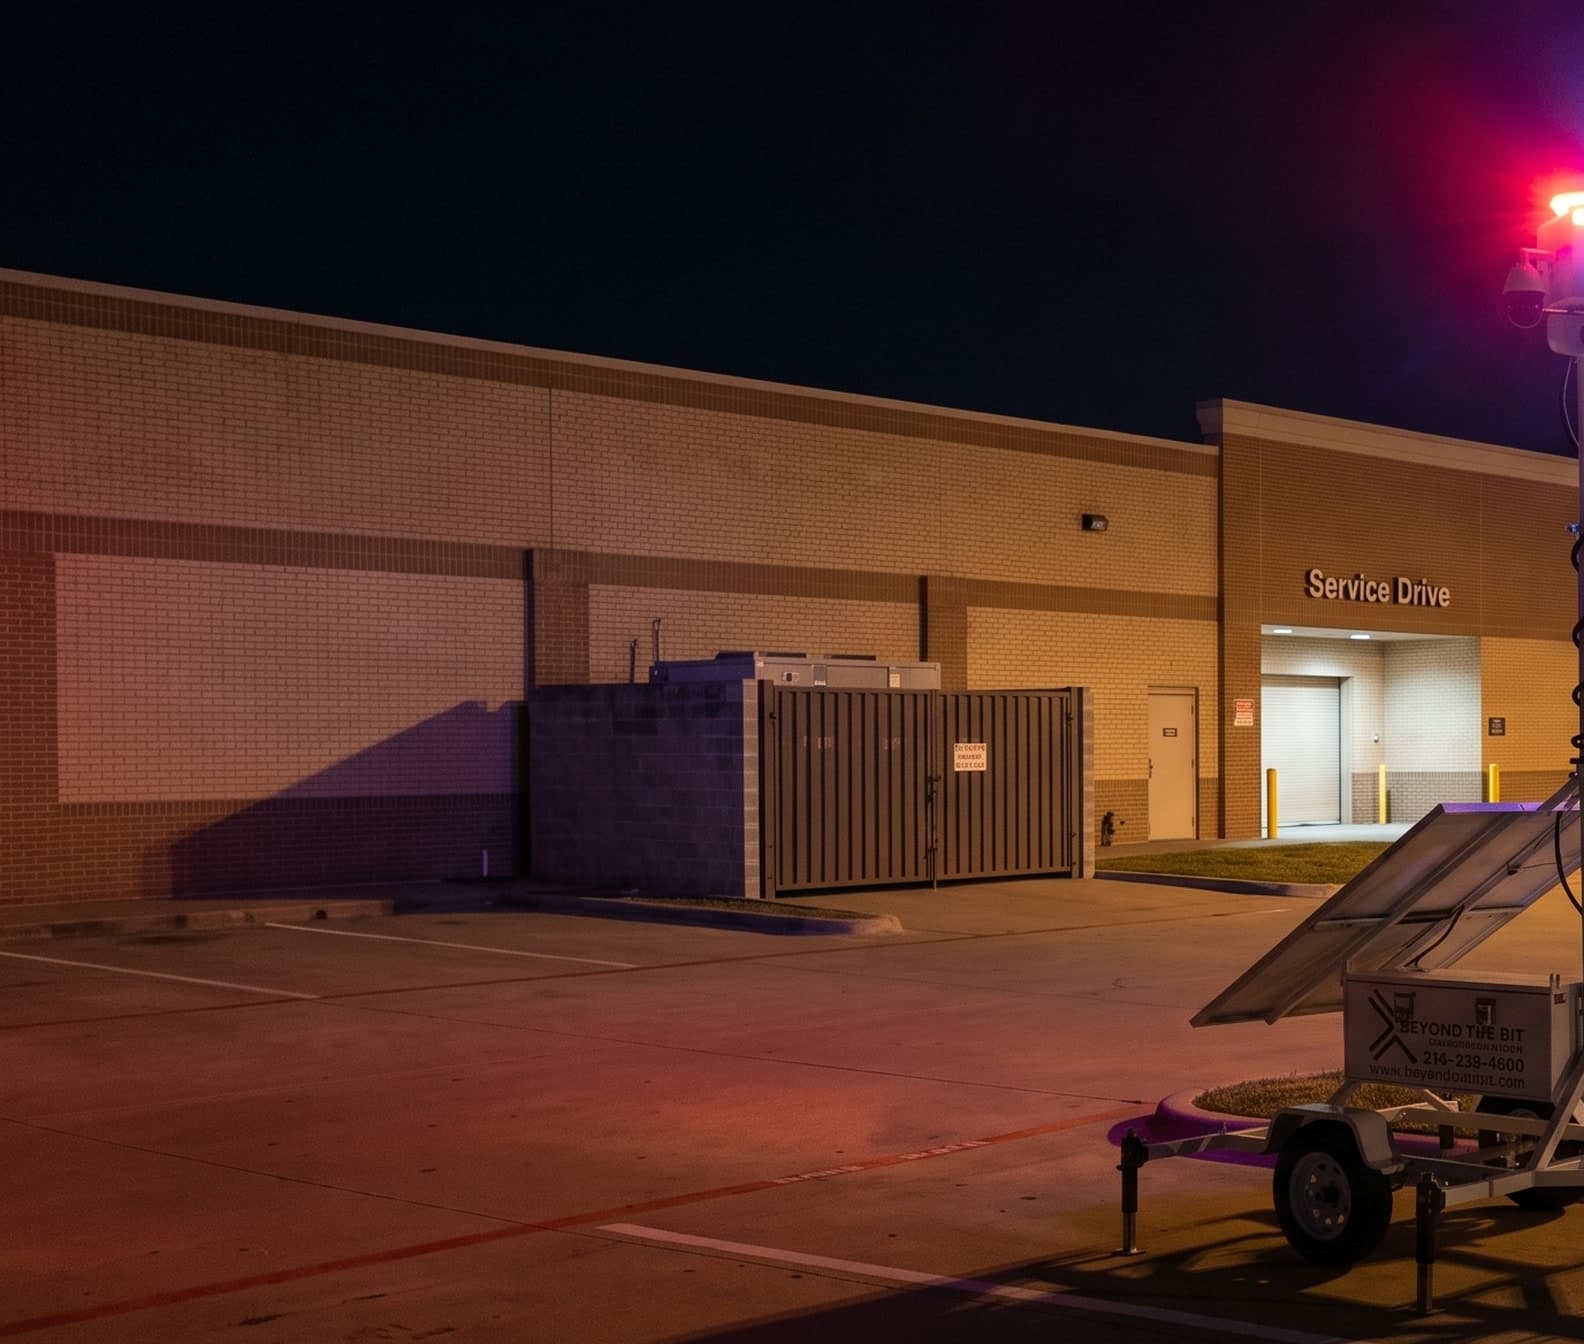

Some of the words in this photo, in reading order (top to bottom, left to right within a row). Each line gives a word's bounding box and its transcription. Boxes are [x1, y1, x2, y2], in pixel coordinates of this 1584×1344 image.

[1307, 567, 1391, 604] Service
[1397, 576, 1450, 608] Drive
[1400, 1020, 1463, 1038] BEYOND
[1466, 1023, 1495, 1041] THE
[1500, 1027, 1526, 1042] BIT
